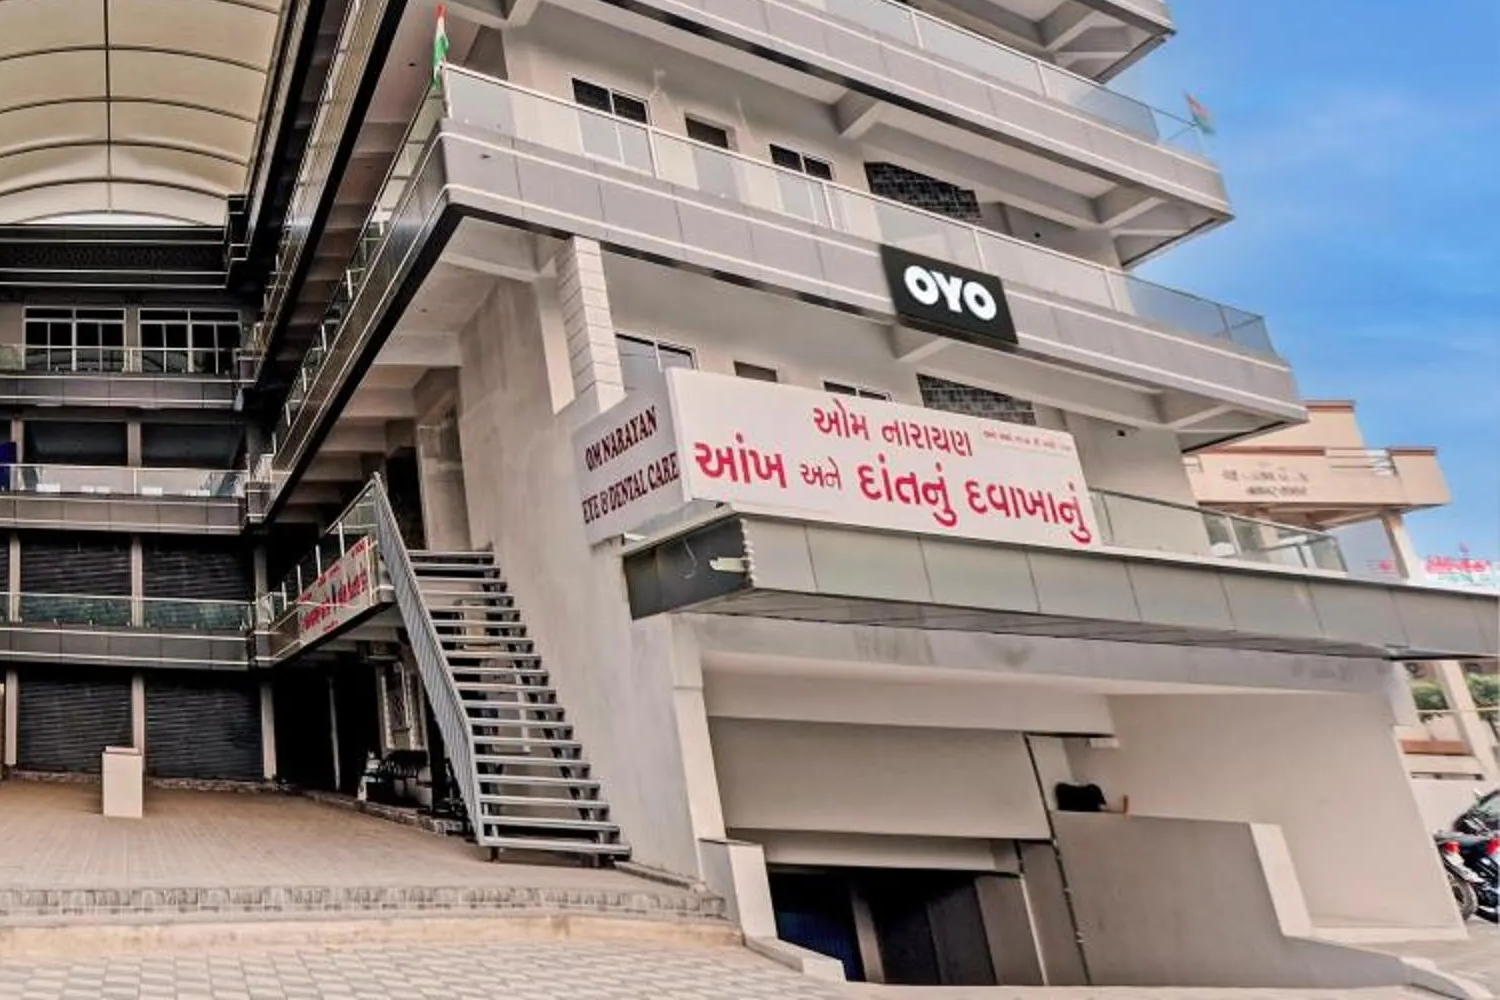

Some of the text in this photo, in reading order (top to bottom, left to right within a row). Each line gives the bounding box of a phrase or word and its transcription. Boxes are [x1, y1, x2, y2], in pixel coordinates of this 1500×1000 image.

[903, 265, 998, 321] OYO
[585, 405, 658, 472] OM NARAYAN
[813, 398, 870, 441] ઓમ
[881, 420, 973, 457] નારાયણ
[608, 468, 648, 511] DENTAL
[647, 451, 680, 490] CARE
[694, 432, 1092, 545] આંખ અને દાંતનું દવાખાનું
